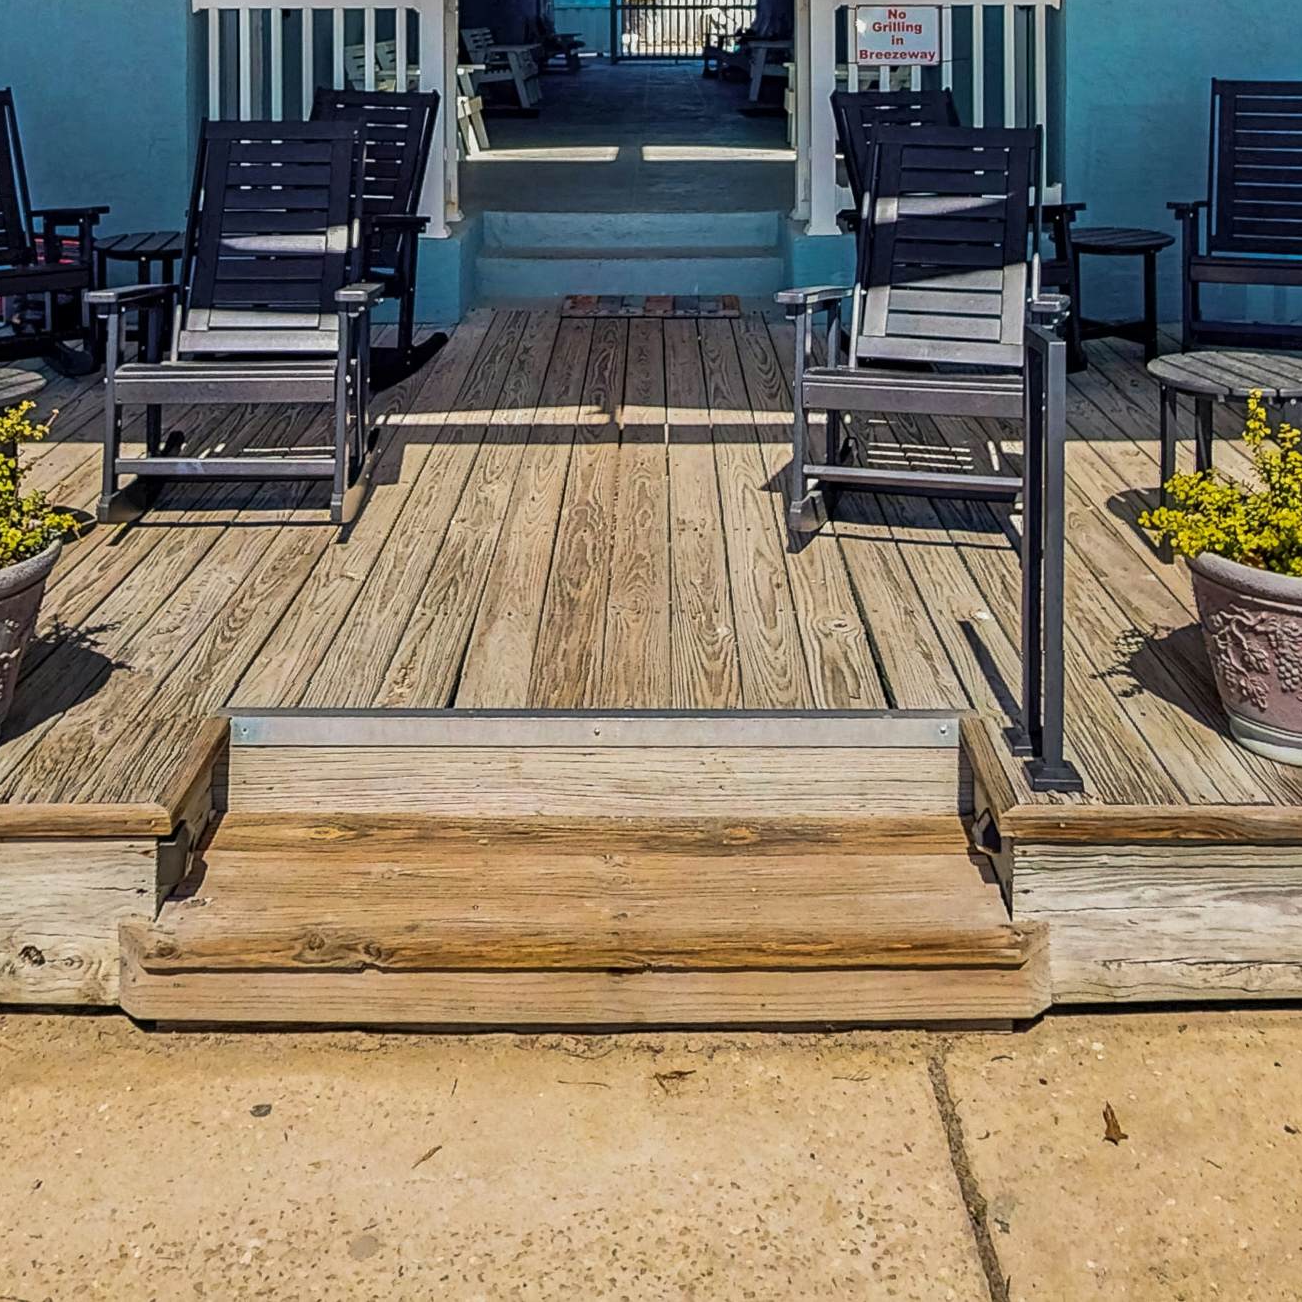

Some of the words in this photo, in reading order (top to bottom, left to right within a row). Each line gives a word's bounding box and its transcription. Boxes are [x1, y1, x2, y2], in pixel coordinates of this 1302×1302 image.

[888, 9, 907, 19] No
[872, 21, 923, 34] Grilling
[891, 35, 904, 45] in
[859, 49, 936, 62] Breezeway
